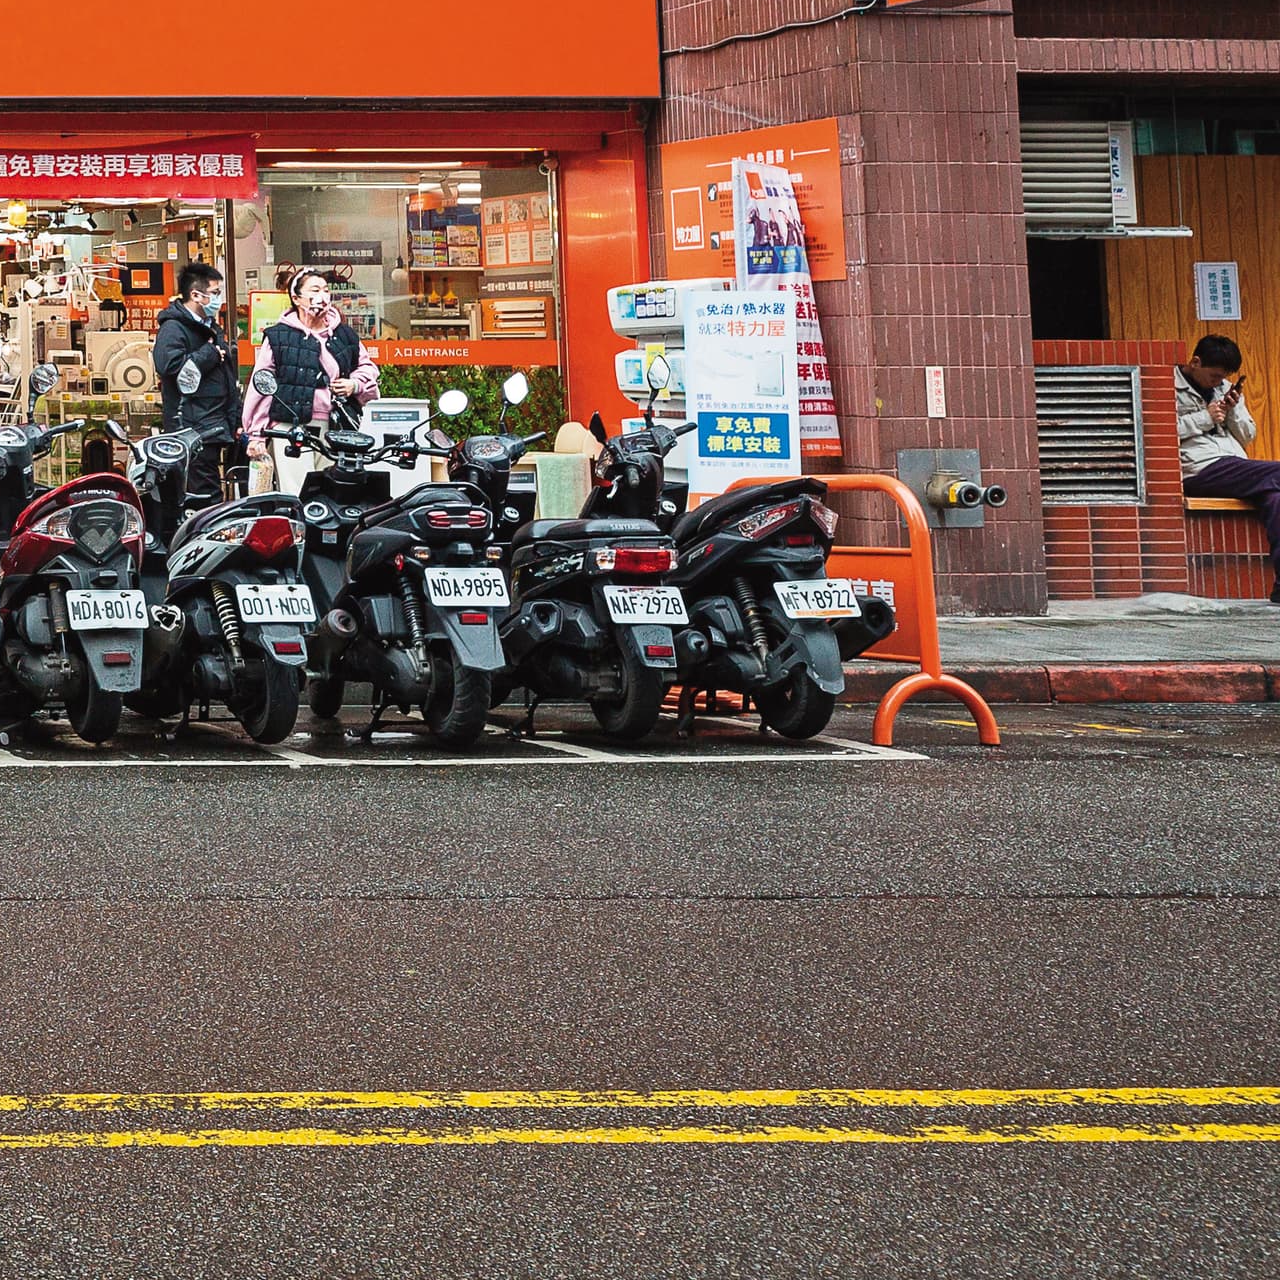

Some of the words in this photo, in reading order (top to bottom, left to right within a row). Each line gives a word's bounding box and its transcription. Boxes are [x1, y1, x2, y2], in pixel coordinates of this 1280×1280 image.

[716, 416, 771, 434] 享免費
[707, 435, 781, 454] 標準安裝
